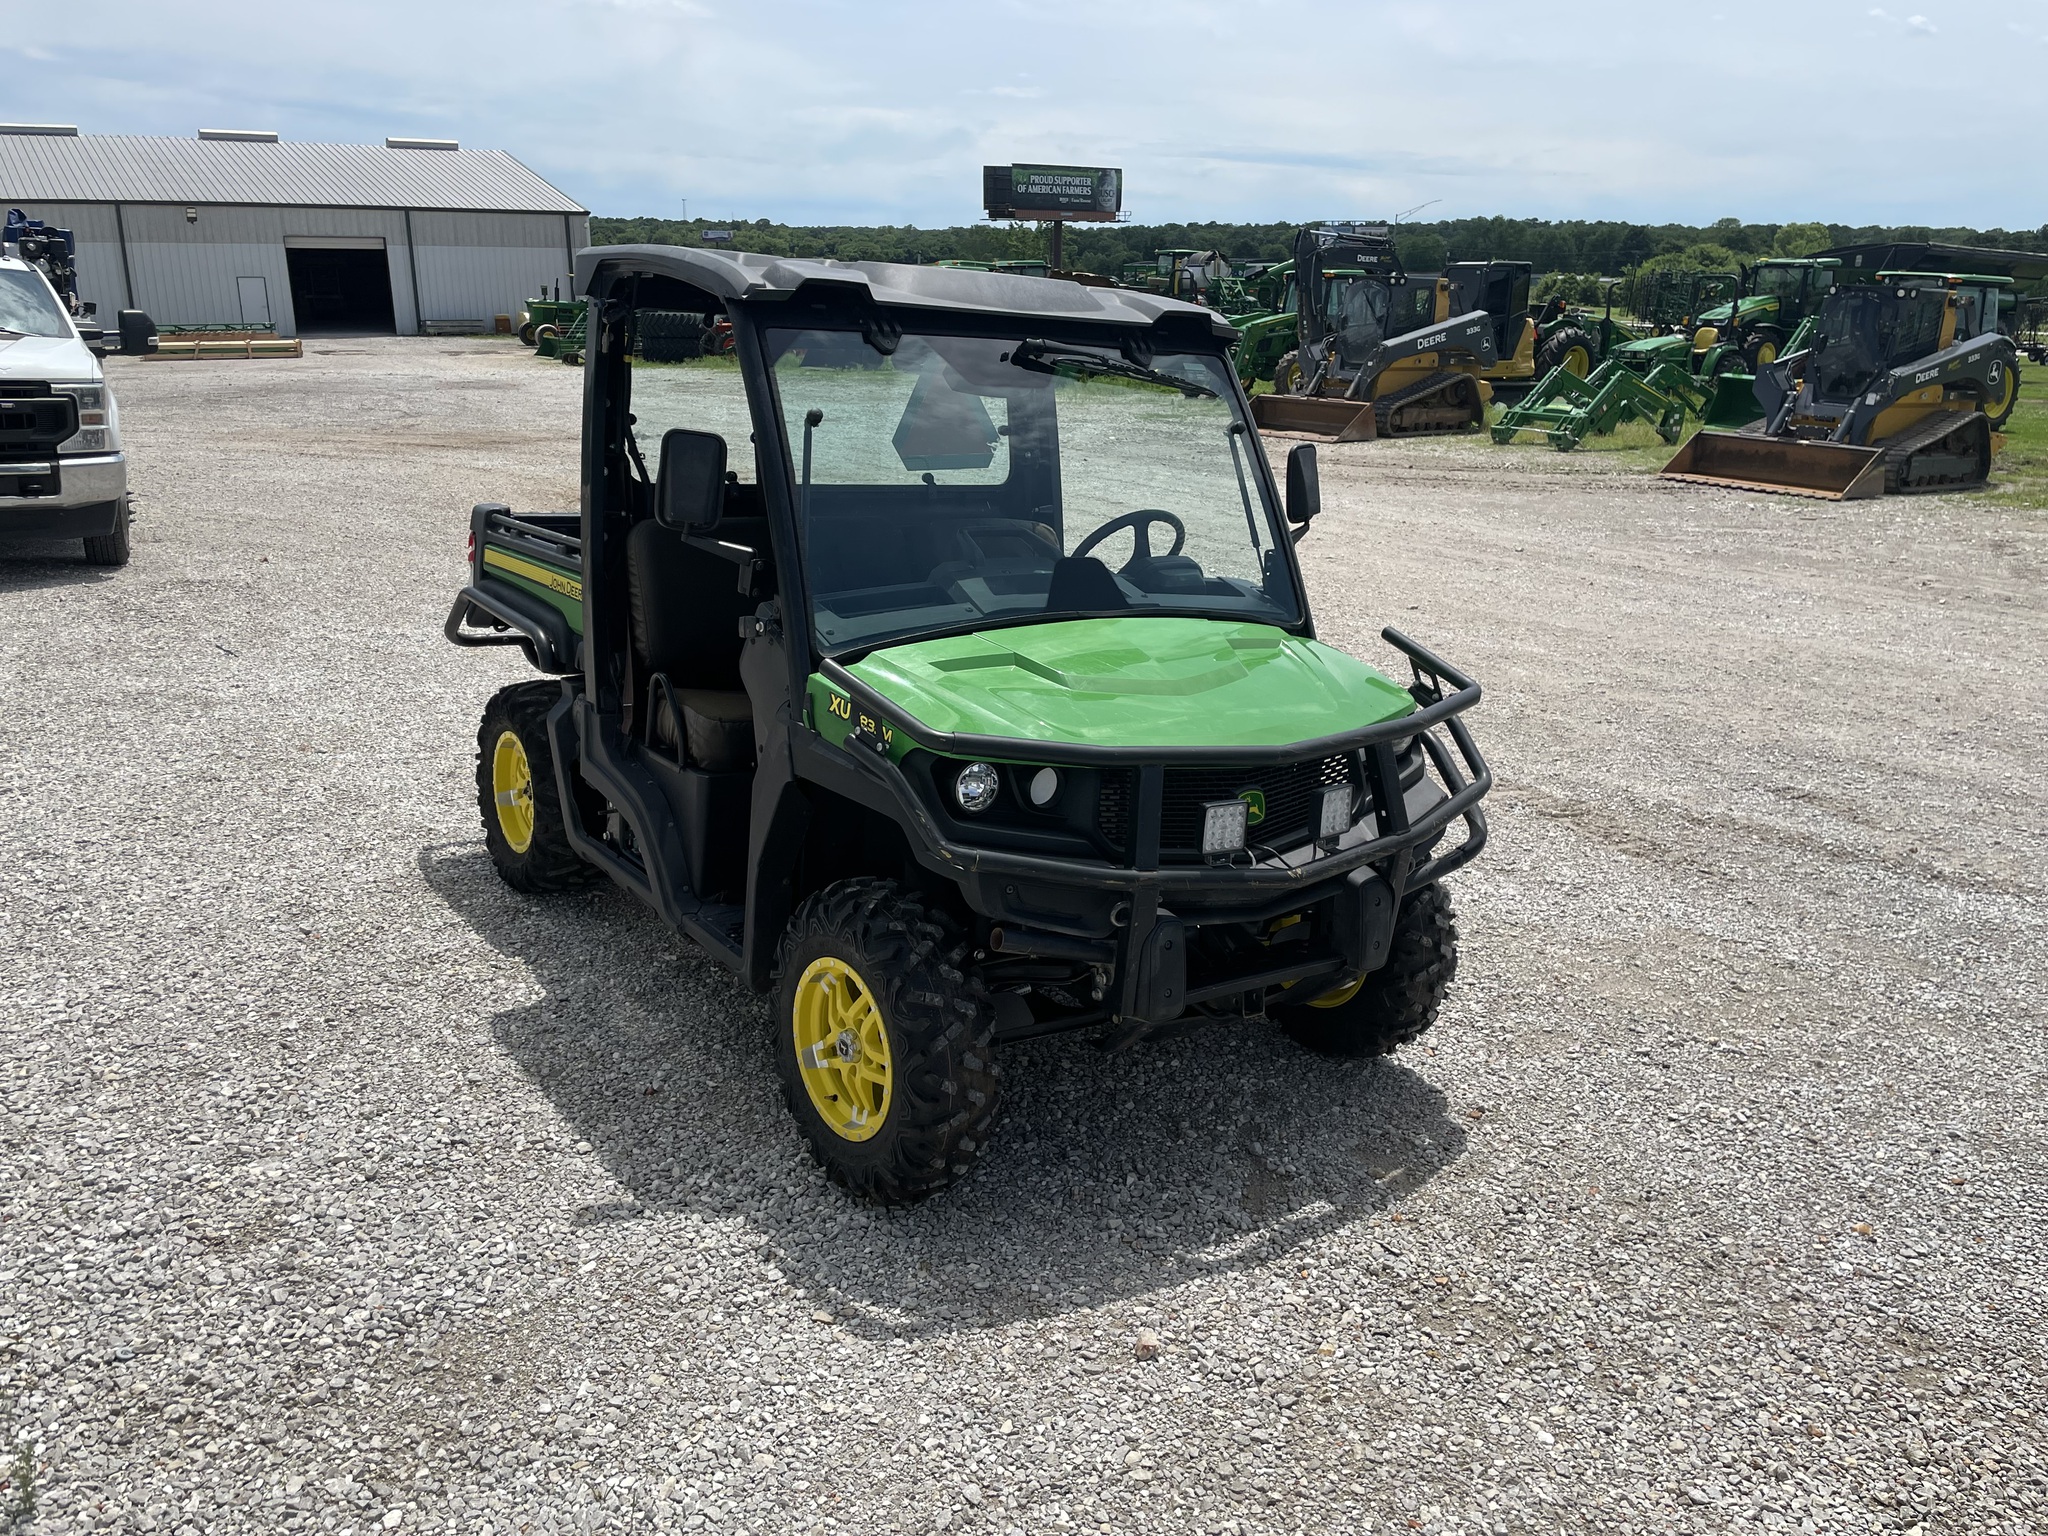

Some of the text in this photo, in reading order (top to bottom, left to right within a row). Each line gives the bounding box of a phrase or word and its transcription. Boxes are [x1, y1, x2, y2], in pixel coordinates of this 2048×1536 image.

[1030, 175, 1092, 186] PROUD SUPPORTER
[1017, 184, 1092, 195] OF AMERICAN FARMERS
[1357, 254, 1378, 263] DEERE
[1466, 325, 1481, 336] 333G
[1417, 332, 1447, 350] DEERE
[1915, 367, 1940, 384] DEERE
[549, 575, 583, 601] JOHN DEER
